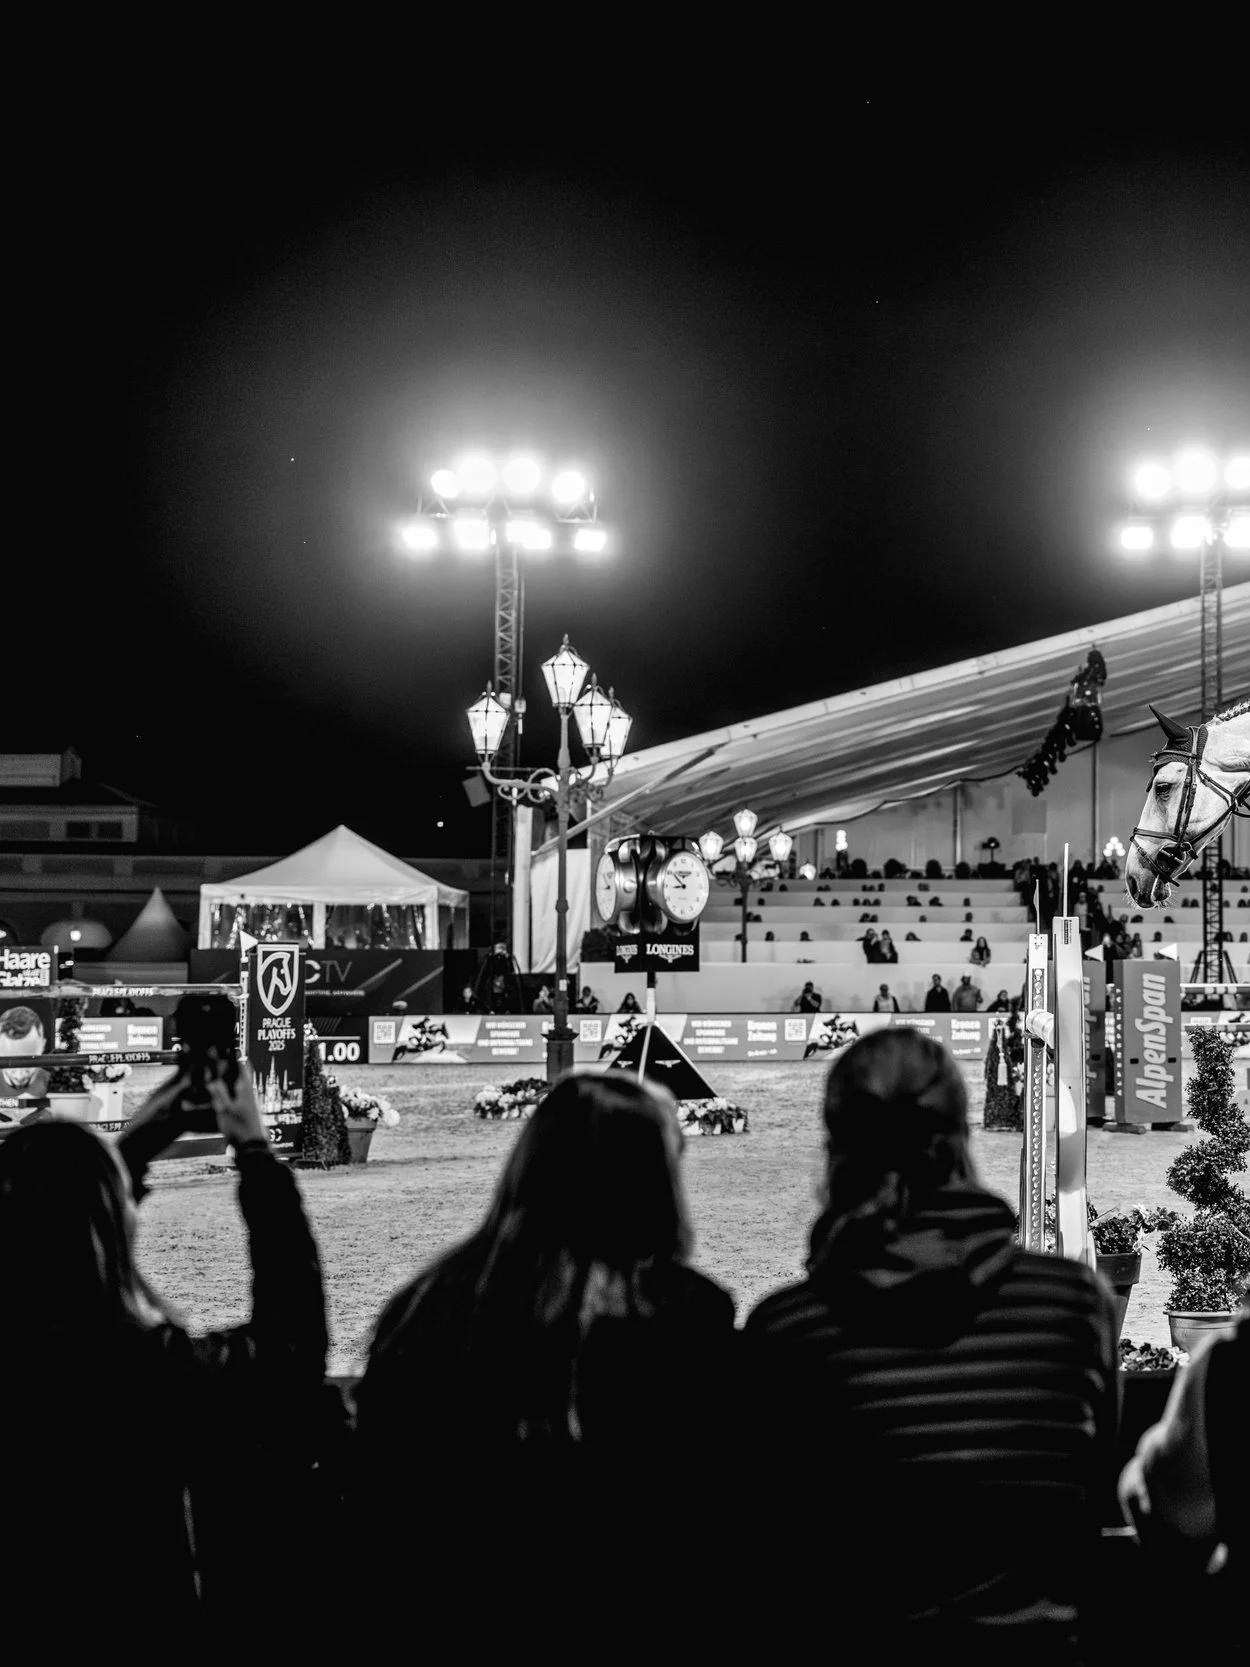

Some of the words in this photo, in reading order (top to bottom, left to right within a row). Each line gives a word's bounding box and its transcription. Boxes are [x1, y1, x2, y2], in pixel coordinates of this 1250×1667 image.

[646, 943, 695, 955] LONGINES
[262, 1017, 292, 1029] PRAGUE
[258, 1028, 297, 1041] PLAYOFFS
[268, 1039, 286, 1052] 2025
[1134, 973, 1175, 1110] AlpenSpan
